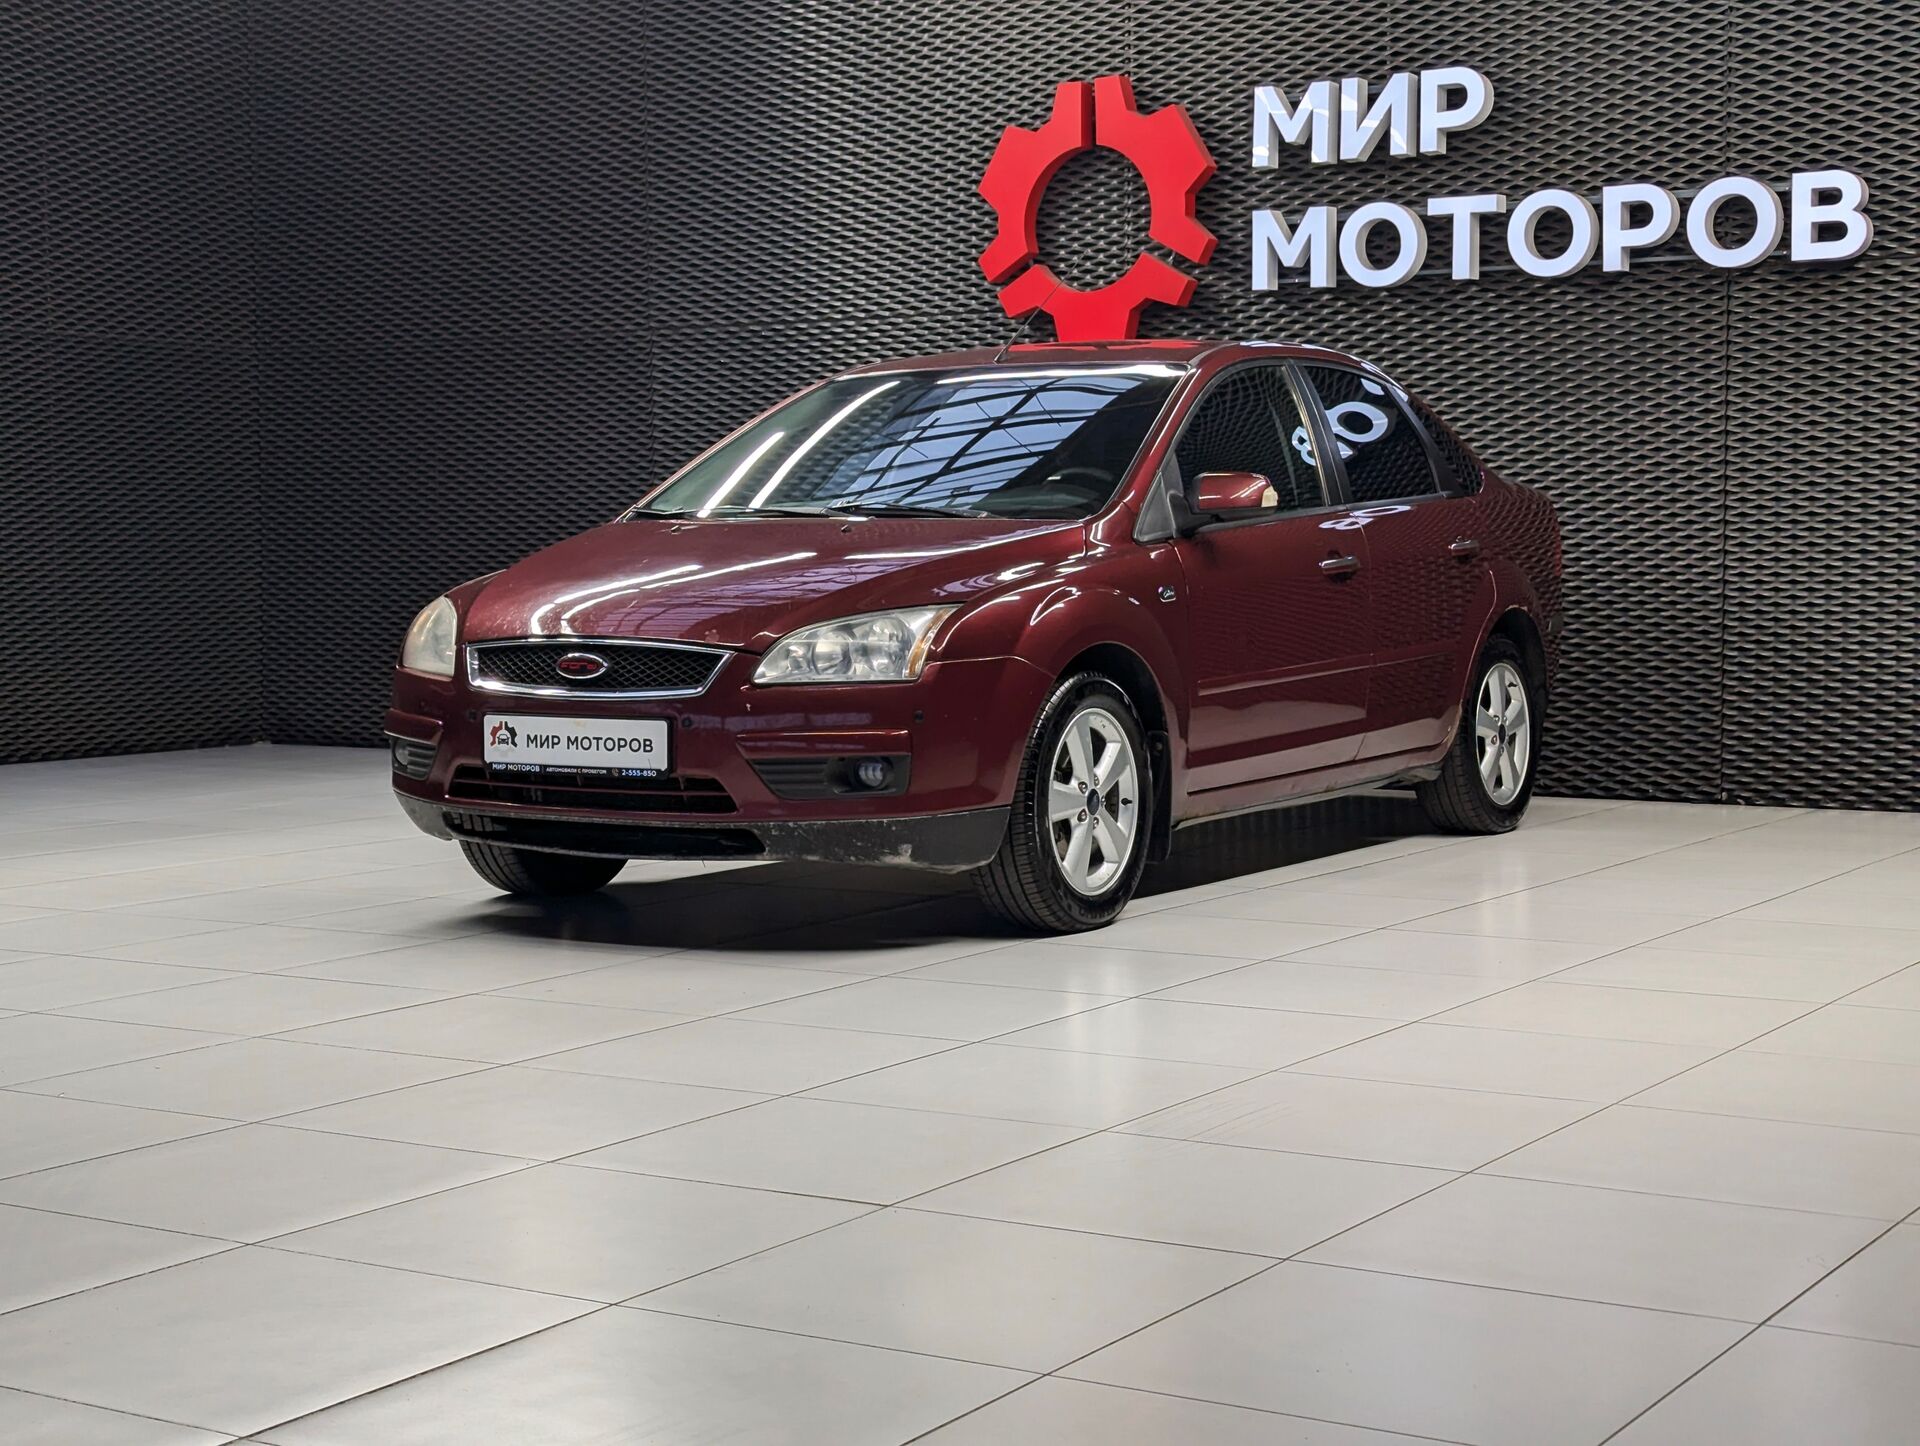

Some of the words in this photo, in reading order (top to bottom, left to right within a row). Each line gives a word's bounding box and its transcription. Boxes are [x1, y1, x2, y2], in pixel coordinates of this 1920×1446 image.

[1251, 66, 1495, 168] МИР
[1251, 169, 1875, 291] МОТОРОВ
[492, 762, 507, 770] МИР
[507, 764, 540, 772] МОТОРОВ
[621, 769, 657, 777] 2-555-850
[526, 733, 561, 750] МИР
[566, 735, 654, 753] МОТОРОВ
